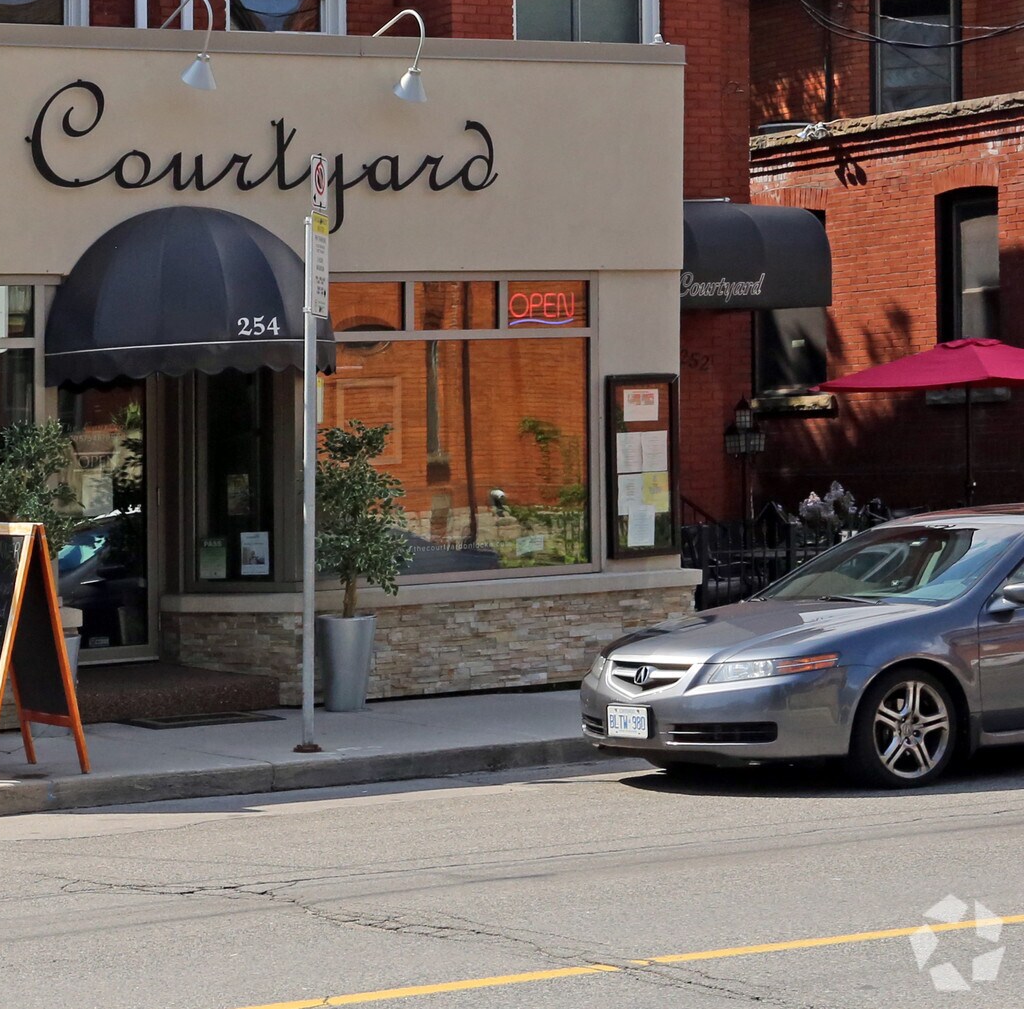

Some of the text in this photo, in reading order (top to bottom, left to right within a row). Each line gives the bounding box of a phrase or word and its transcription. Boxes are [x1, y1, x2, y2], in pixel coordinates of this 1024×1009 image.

[24, 78, 499, 234] Courtyard
[680, 271, 766, 303] Courtyard
[509, 292, 575, 319] OPEN
[237, 316, 281, 336] 254
[203, 539, 223, 548] PASS
